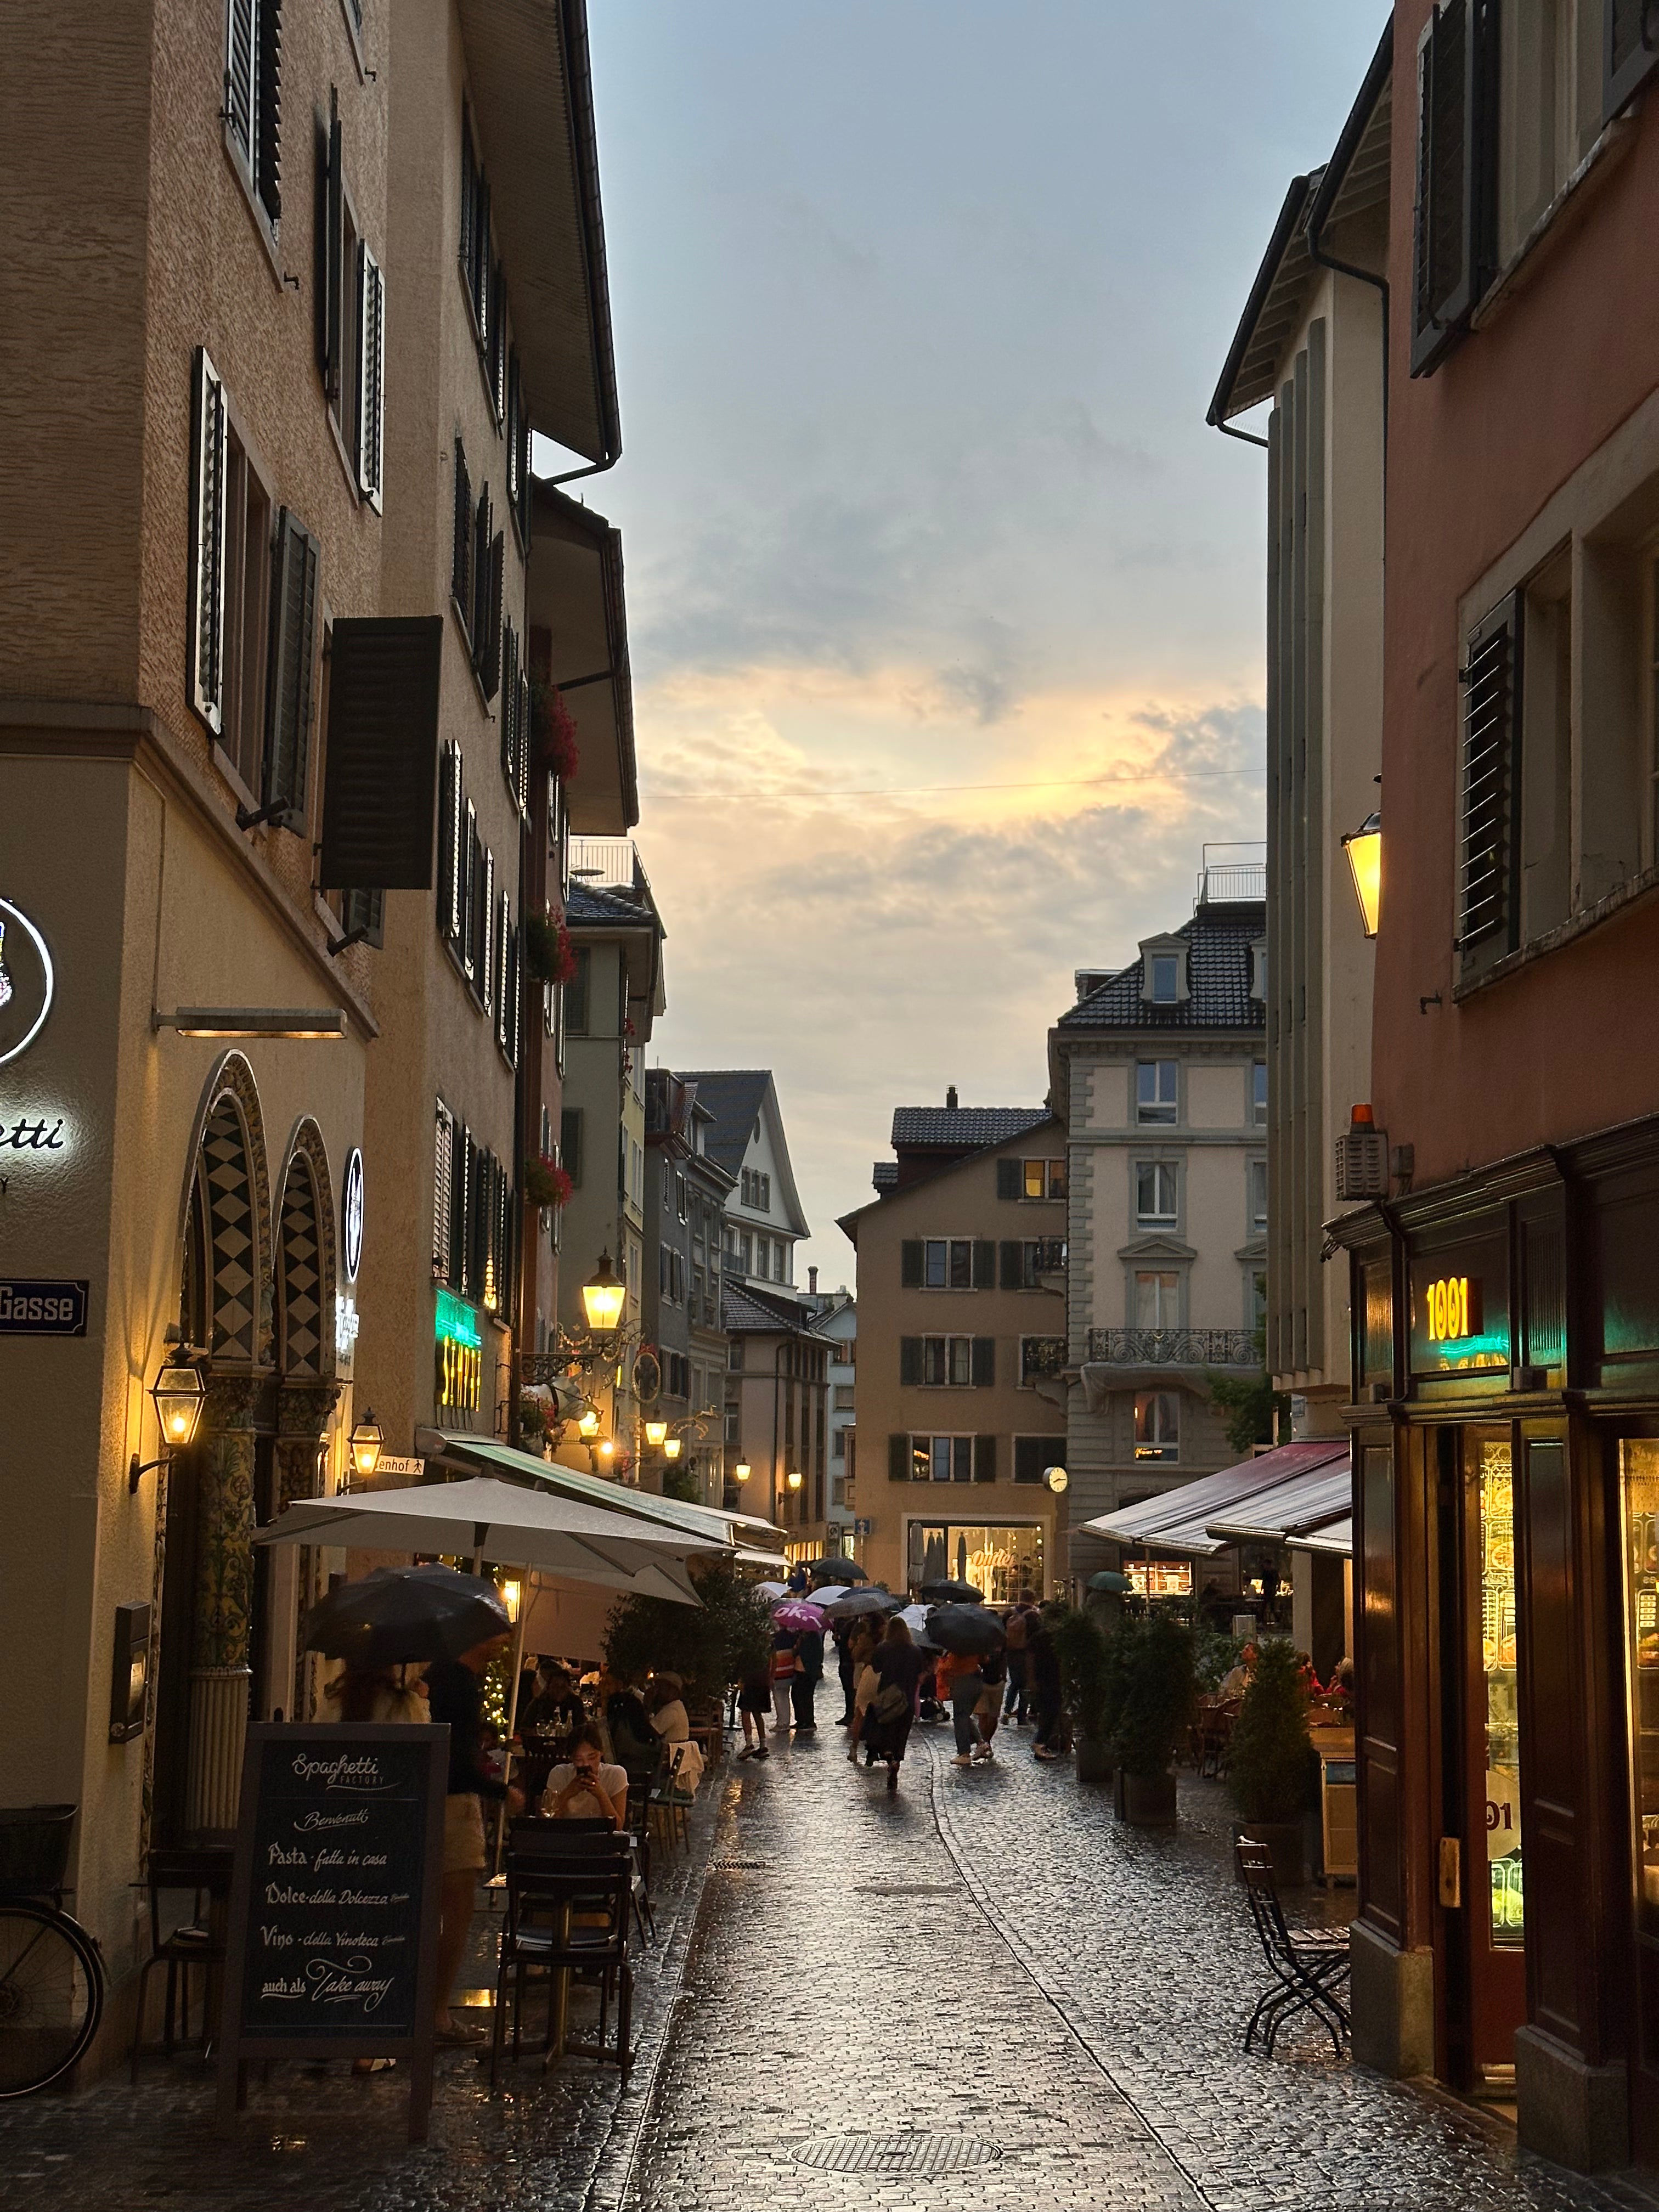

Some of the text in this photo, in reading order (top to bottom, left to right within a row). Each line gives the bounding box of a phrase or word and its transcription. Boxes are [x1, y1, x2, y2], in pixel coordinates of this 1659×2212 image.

[0, 1286, 74, 1321] Gasse
[1427, 1277, 1468, 1340] 1001
[292, 1753, 379, 1784] Spaghetti
[340, 1775, 384, 1784] FACTORY
[268, 1841, 387, 1872] Pasta fatta in casa
[338, 1889, 388, 1904] Dolcezza
[260, 1925, 293, 1950] Vino
[303, 1931, 332, 1946] della
[336, 1931, 379, 1946] Vinoteca
[262, 1977, 287, 1993] auch
[290, 1977, 307, 1993] als
[354, 1977, 394, 2012] away
